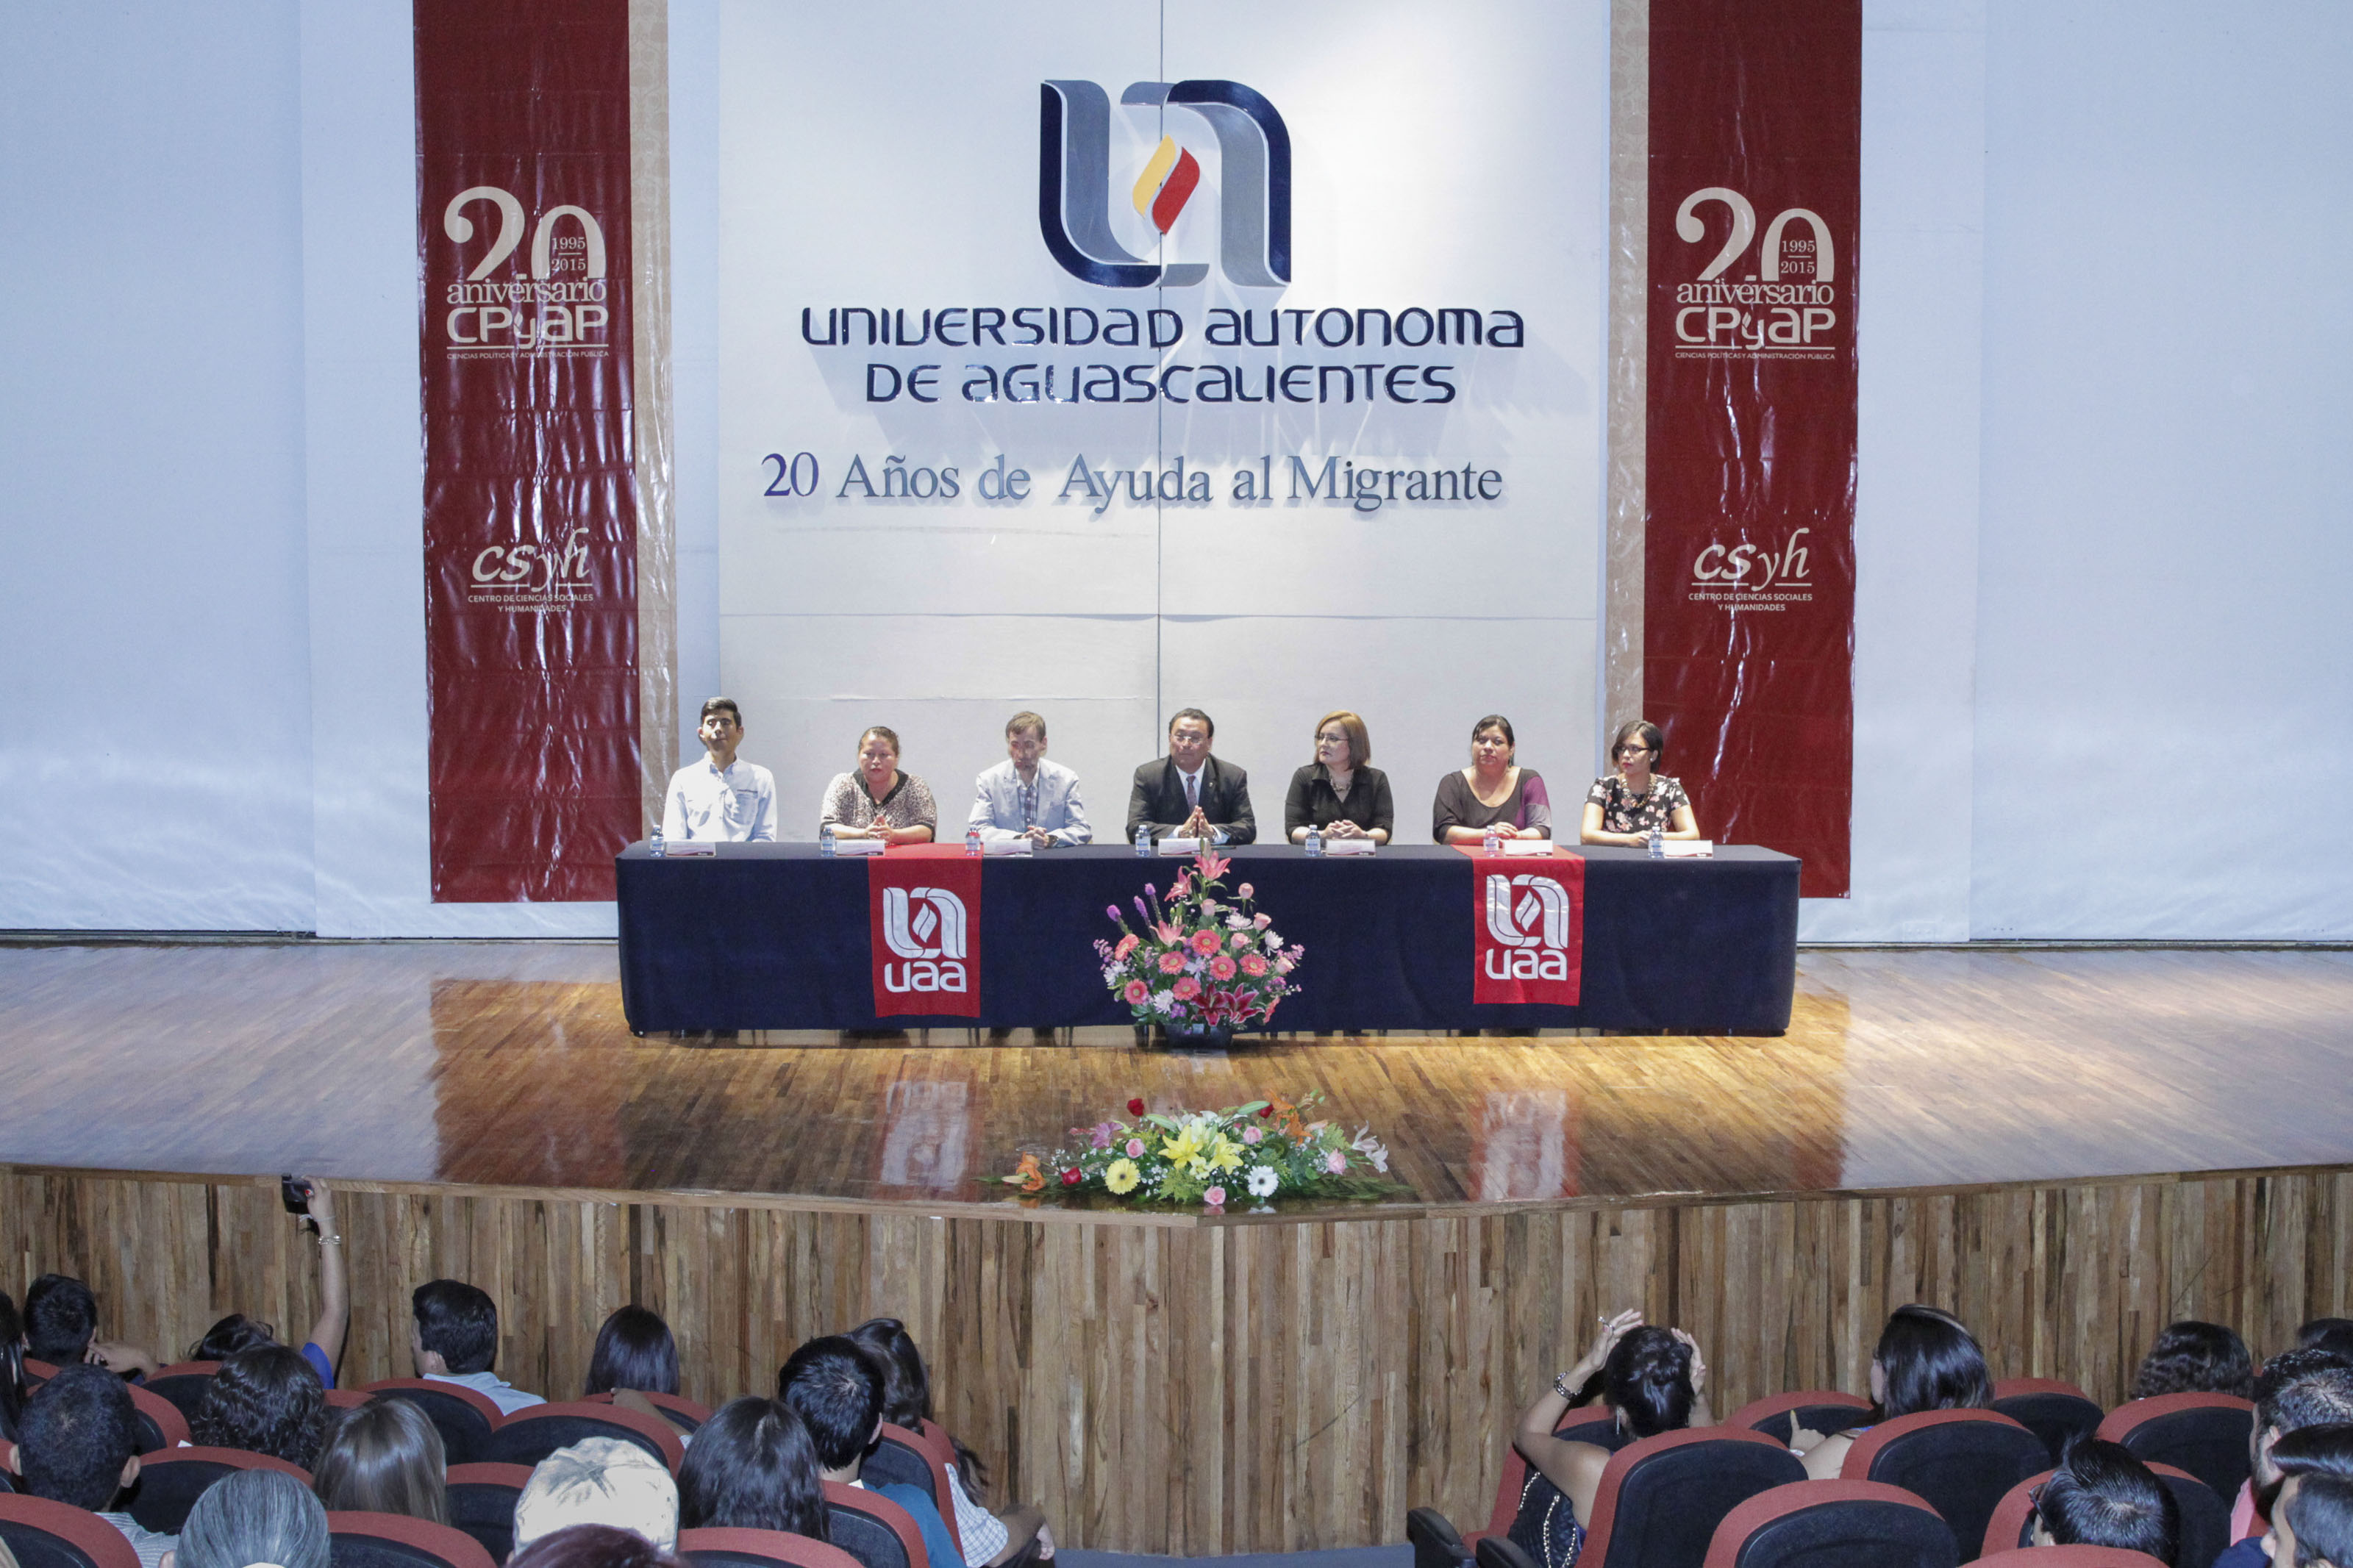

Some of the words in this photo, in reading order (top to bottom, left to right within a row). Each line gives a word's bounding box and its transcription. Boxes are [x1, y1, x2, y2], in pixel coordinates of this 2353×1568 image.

[443, 186, 607, 282] 20
[1676, 187, 1835, 282] 20
[551, 236, 586, 250] 1995
[1782, 240, 1816, 253] 1995
[551, 258, 587, 271] 2015
[1780, 261, 1815, 274] 2015
[446, 276, 607, 304] aniversario
[1676, 279, 1835, 305] aniversario
[447, 352, 478, 360] CIENCIAS
[580, 350, 609, 358] PÚBLICA
[1746, 351, 1806, 359] ADMINISTRACIÓN
[1807, 351, 1835, 360] PÚBLICA
[761, 452, 819, 497] 20
[835, 454, 960, 498] Años
[978, 454, 1031, 499] de
[1057, 453, 1214, 514] Ayuda
[1232, 454, 1274, 500] al
[1287, 455, 1503, 512] Migrante
[471, 527, 590, 593] csyh
[1693, 527, 1810, 592] csyh
[468, 594, 501, 603] CENTRO
[503, 594, 515, 602] DE
[515, 594, 552, 602] CIENCIAS
[554, 593, 593, 602] SOCIALES
[1688, 593, 1722, 601] CENTRO
[1774, 593, 1813, 601] SOCIALES
[505, 604, 567, 613] HUMANIDADES
[1725, 604, 1785, 612] HUMANIDADES
